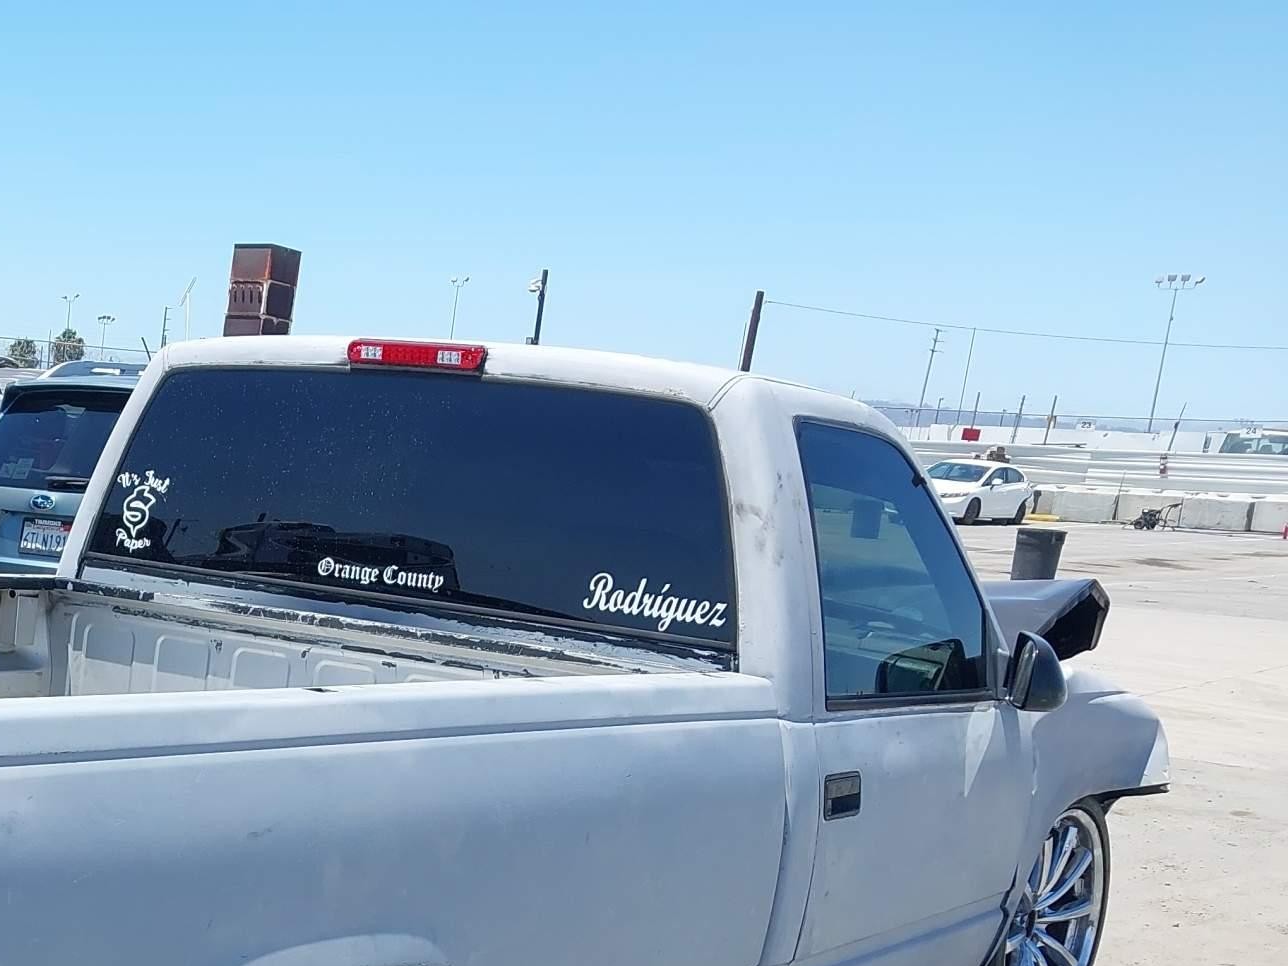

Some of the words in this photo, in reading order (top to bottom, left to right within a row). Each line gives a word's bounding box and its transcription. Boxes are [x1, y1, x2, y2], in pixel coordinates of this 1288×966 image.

[1080, 421, 1092, 429] 23
[1246, 426, 1257, 435] 24
[144, 469, 170, 493] Just
[115, 528, 151, 553] Paper
[317, 556, 380, 585] Orange
[382, 564, 445, 593] County
[582, 572, 728, 632] Rodríguez
